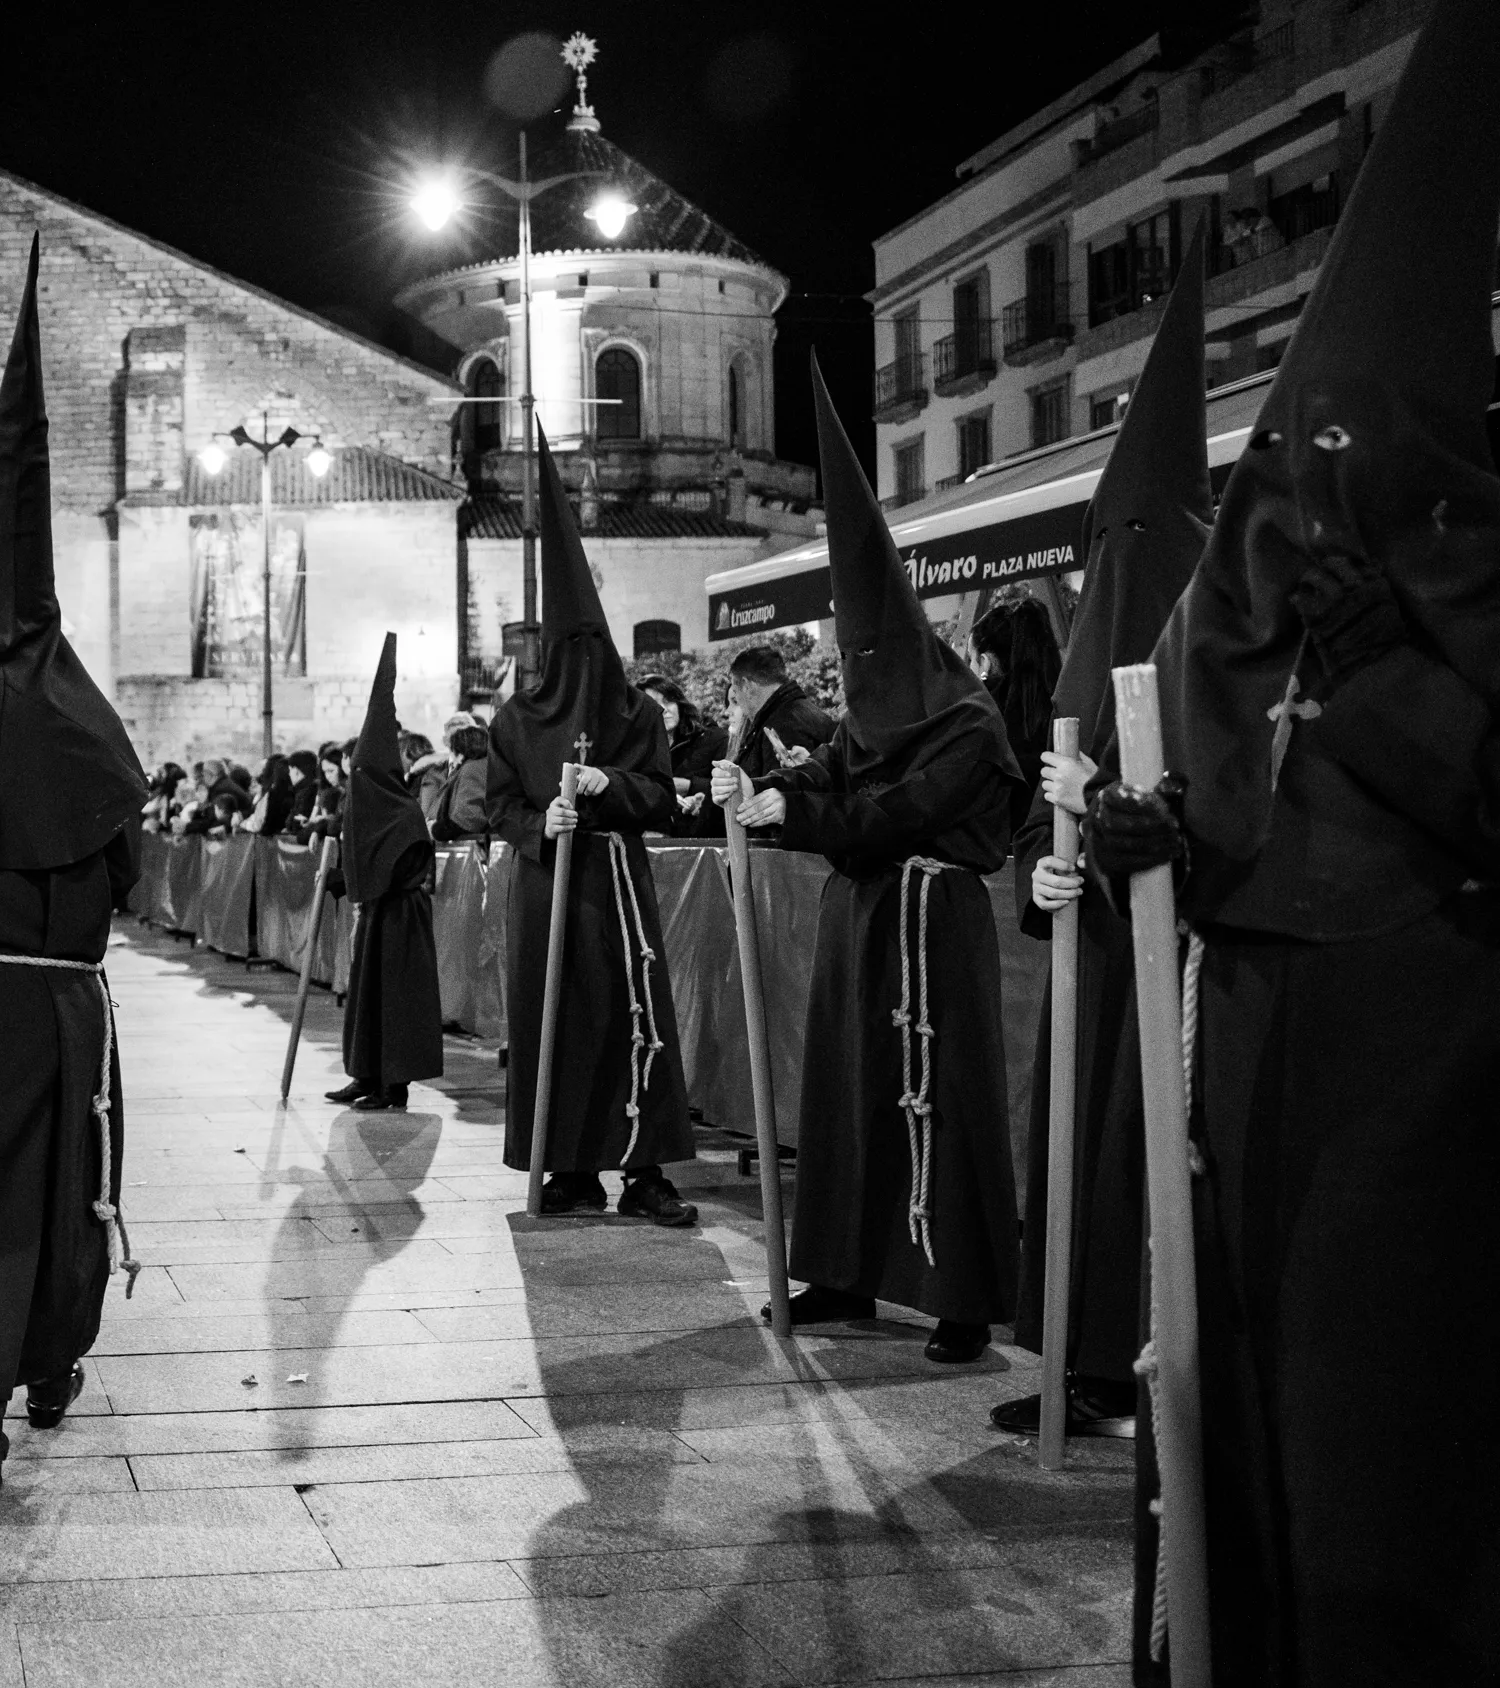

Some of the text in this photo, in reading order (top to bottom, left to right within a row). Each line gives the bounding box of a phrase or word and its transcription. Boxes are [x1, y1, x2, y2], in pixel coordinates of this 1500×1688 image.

[903, 545, 1075, 591] Álvaro PLAZA NUEVA
[731, 604, 775, 628] Cruzcampo
